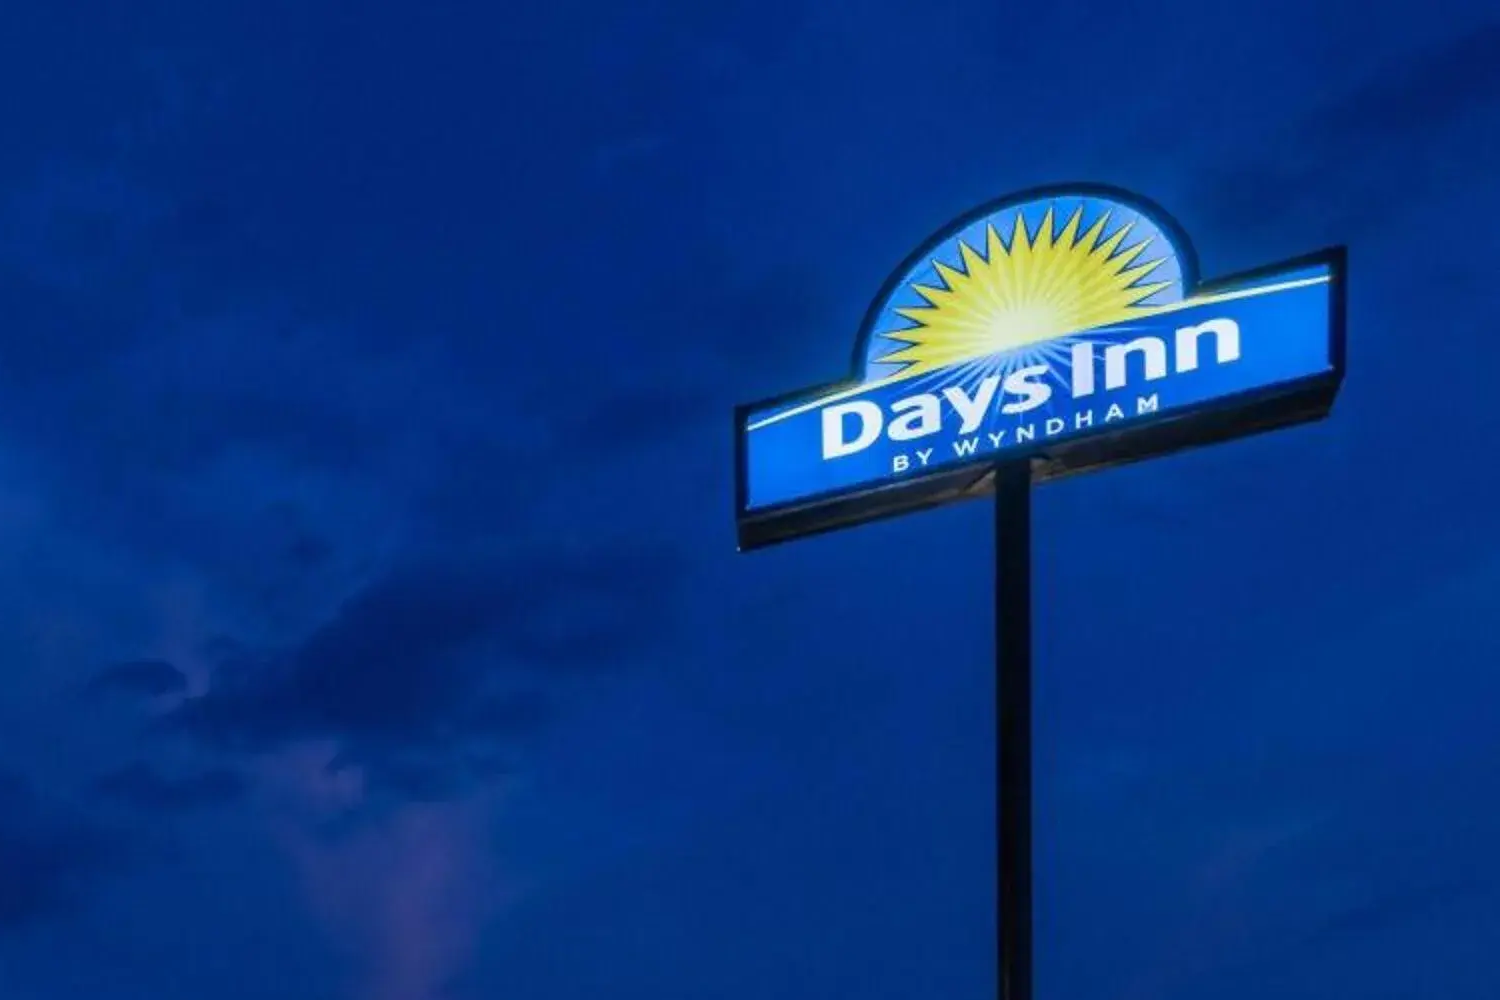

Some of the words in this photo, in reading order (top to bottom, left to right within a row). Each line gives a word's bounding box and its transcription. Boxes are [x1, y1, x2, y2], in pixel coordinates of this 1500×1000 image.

[821, 361, 1051, 460] Days
[1072, 316, 1240, 394] Inn
[893, 448, 933, 473] BY
[953, 394, 1159, 455] WYNDHAM
